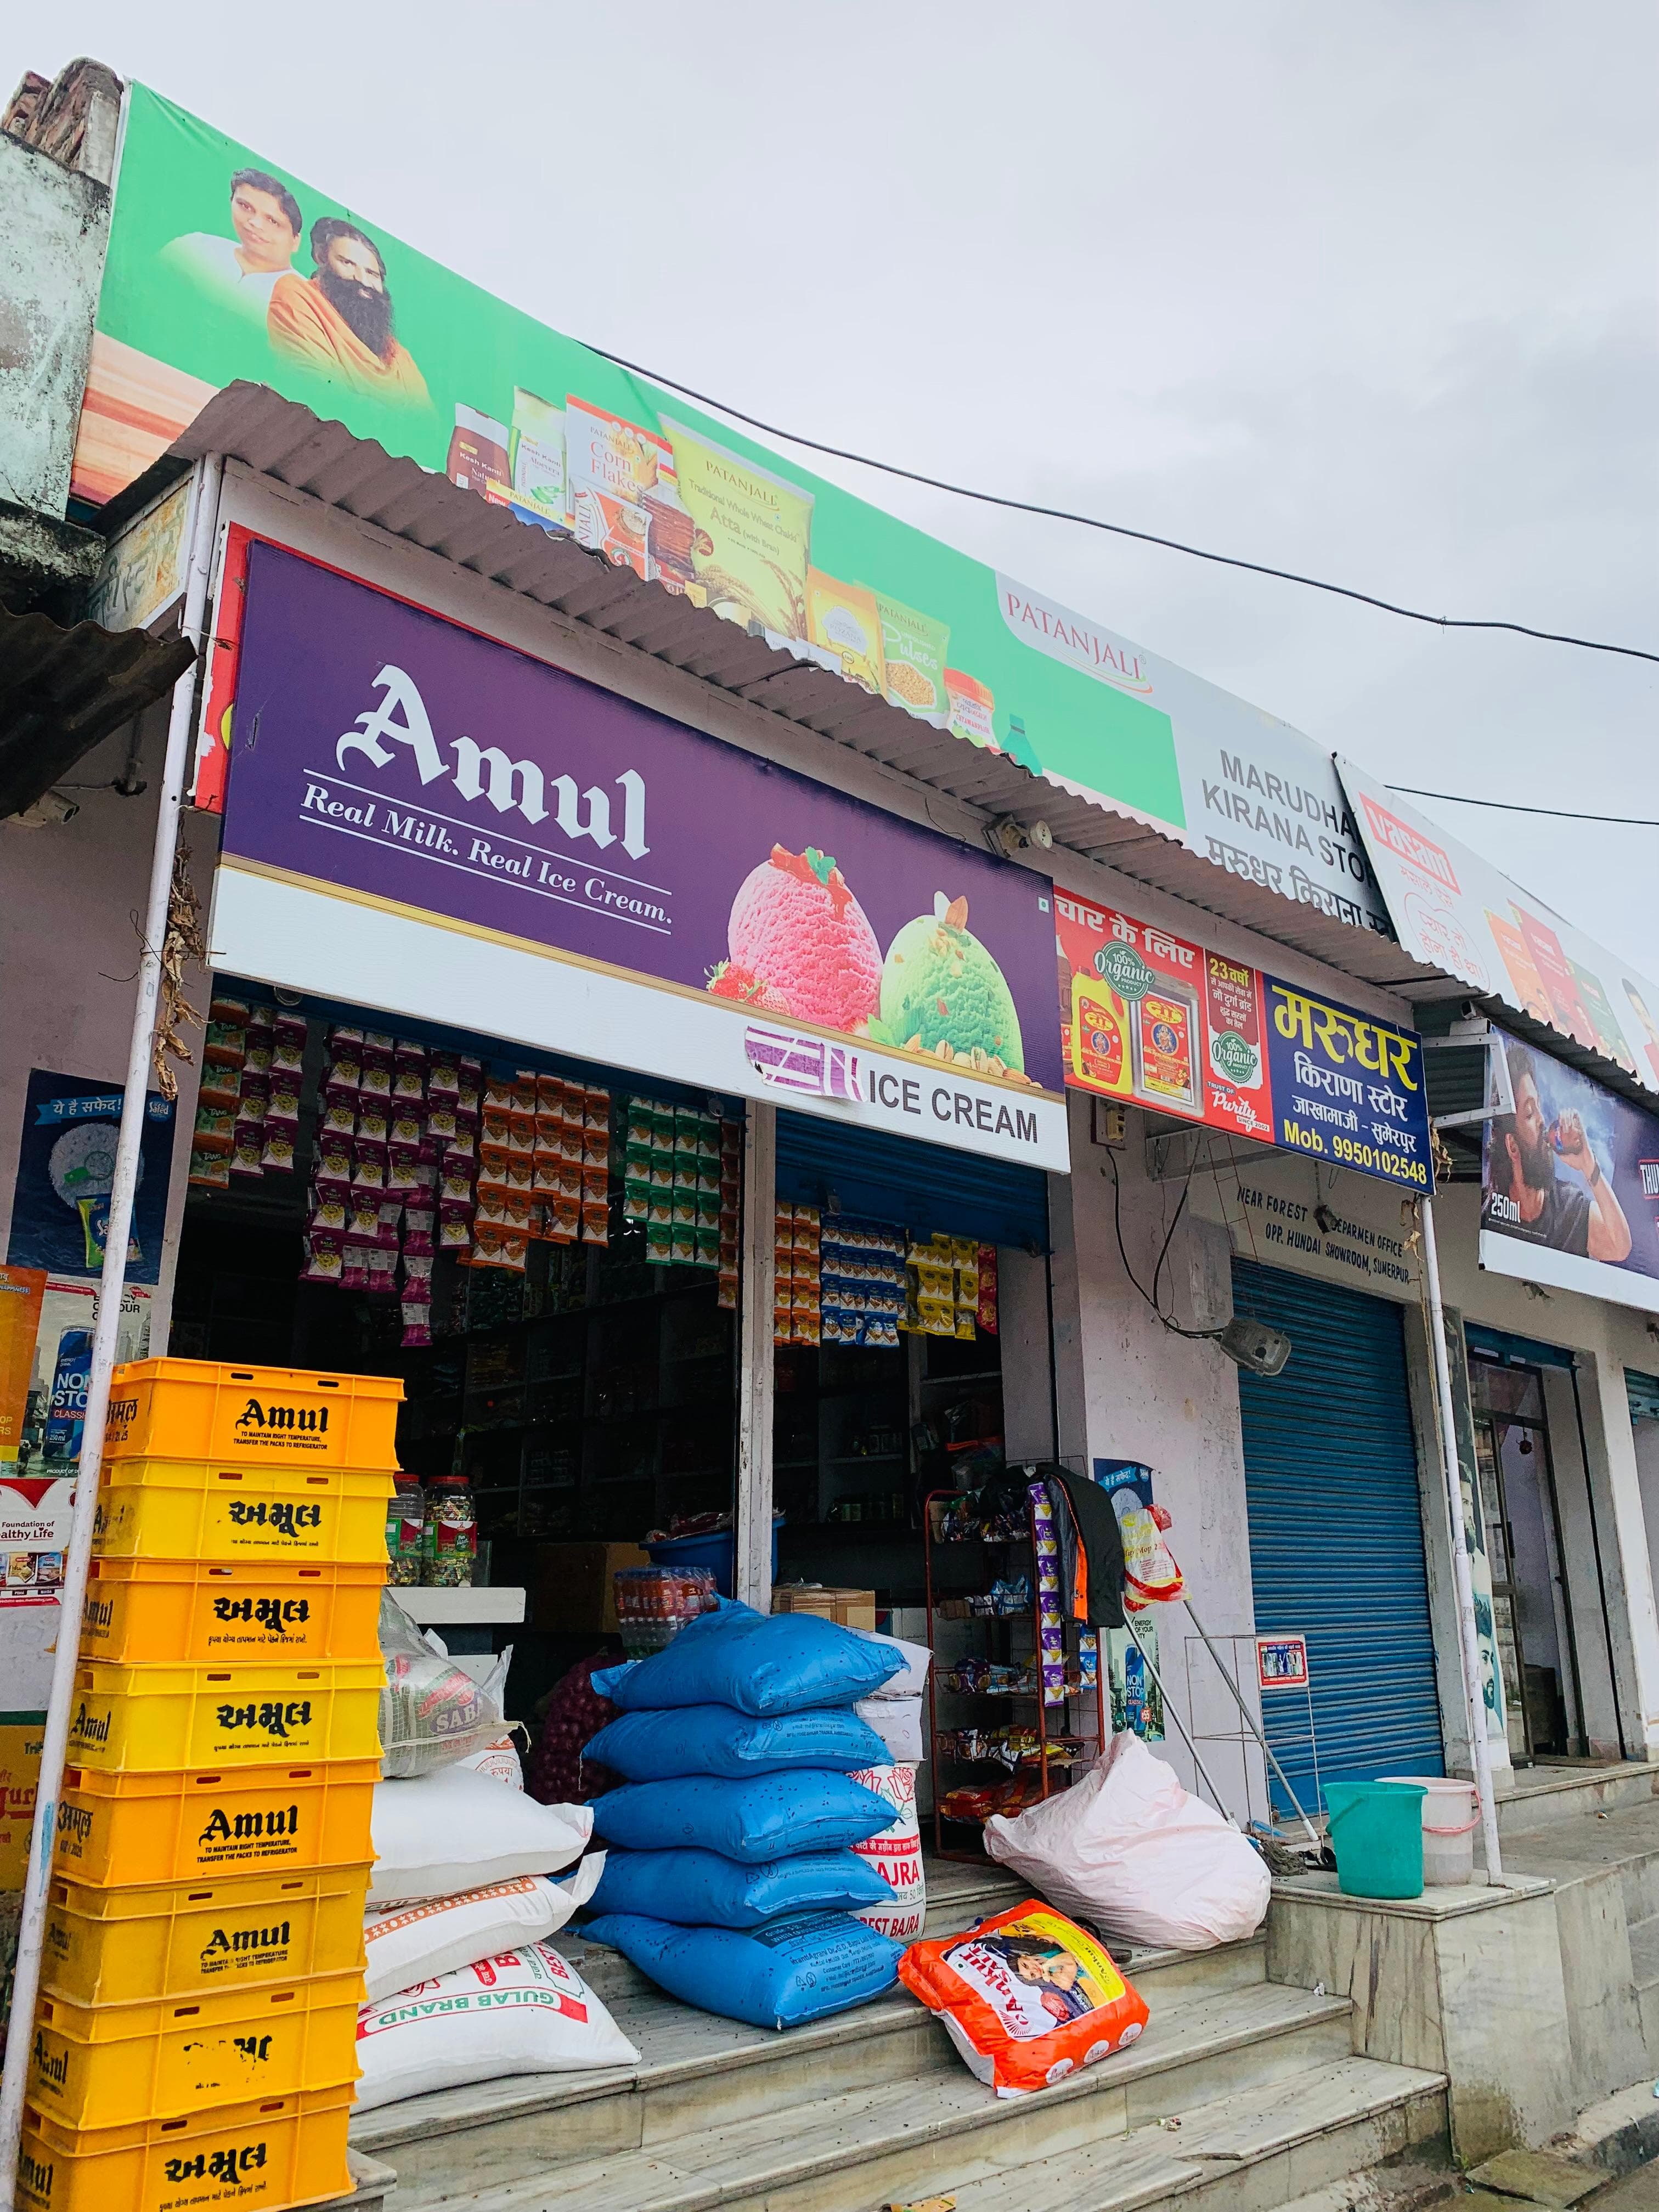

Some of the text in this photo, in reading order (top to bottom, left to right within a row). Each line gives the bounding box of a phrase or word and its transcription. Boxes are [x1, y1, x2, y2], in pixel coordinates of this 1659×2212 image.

[590, 427, 633, 450] PATANJALI
[460, 452, 501, 476] Kesh Kanti
[591, 441, 631, 472] Corn
[591, 459, 646, 496] Flakes
[706, 461, 777, 505] PATANJALI
[510, 492, 550, 516] PATANJALI
[689, 478, 774, 531] Traditional Whole Wheat
[710, 506, 741, 534] Atta
[879, 603, 928, 633] PATANJALI
[882, 621, 938, 670] Pulses
[1006, 591, 1141, 680] PATANJALI
[336, 663, 651, 861] Amul
[1202, 779, 1314, 856] KIRANA
[300, 783, 672, 925] Real Milk. Real Ice Cream.
[1109, 913, 1139, 944] के
[1142, 927, 1195, 969] लिए
[1094, 951, 1154, 984] Organic
[1113, 952, 1135, 966] 100%
[1209, 957, 1228, 979] 23
[1121, 977, 1142, 987] PRODUCT
[1210, 976, 1217, 985] से
[1217, 979, 1235, 994] आपकी
[1235, 985, 1246, 997] सेवा
[1212, 988, 1224, 1002] नौ
[220, 1022, 236, 1030] TANG
[1212, 1040, 1257, 1066] Organic
[1226, 1040, 1243, 1052] 100%
[215, 1065, 233, 1073] TANG
[1207, 1081, 1226, 1092] TRUST
[1294, 1051, 1408, 1122] किराणा स्टोर
[53, 1096, 122, 1116] ये है सफेद!
[209, 1108, 228, 1116] TANG
[870, 1070, 1037, 1144] ICE CREAM
[1211, 1090, 1257, 1133] Purity
[1238, 1116, 1269, 1131] SINCE 2002
[1371, 1121, 1417, 1154] सुमेरपुर
[203, 1152, 222, 1160] TANG
[1284, 1119, 1427, 1185] Mob. 9950102548
[1237, 1187, 1263, 1209] NEAR
[1266, 1195, 1308, 1222] FOREST
[1377, 1234, 1403, 1259] OFFICE
[1491, 1192, 1522, 1223] 250ml
[1266, 1222, 1410, 1284] OPP. HUNDAI SHOWROOM, SUMERPUR
[235, 1398, 329, 1433] Amul
[33, 1528, 54, 1539] Life
[228, 1500, 322, 1538] અમૂલ
[212, 1596, 311, 1633] અમૂલ
[1126, 1675, 1143, 1687] NON
[1127, 1686, 1145, 1698] STOP
[216, 1701, 313, 1739] અમૂલ
[199, 1804, 298, 1847] Amul
[197, 1854, 224, 1863] TRANSFER
[200, 1920, 291, 1961] Amul
[889, 1913, 920, 1937] BAJRA
[537, 1946, 571, 1980] BEST
[968, 1946, 1012, 1983] SALT
[959, 1953, 1024, 2013] Ankur
[378, 1990, 555, 2025] GULAB BRAND
